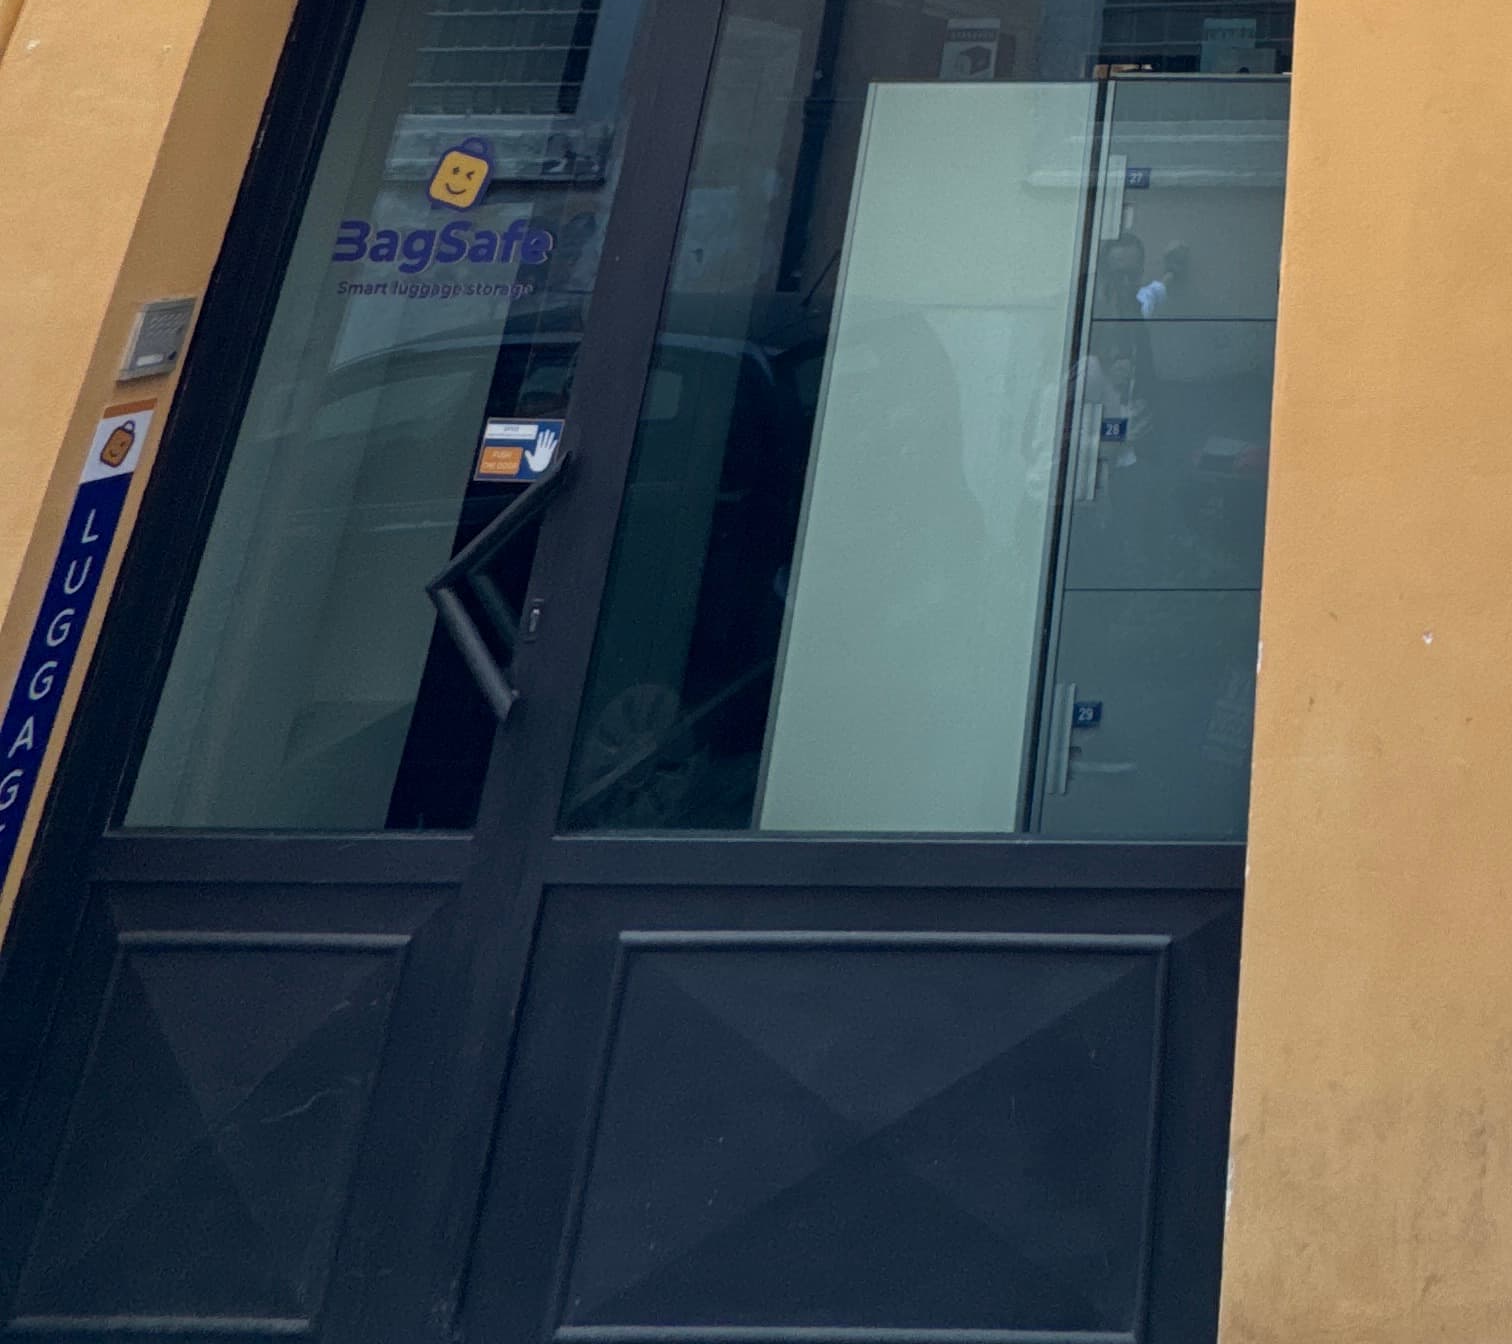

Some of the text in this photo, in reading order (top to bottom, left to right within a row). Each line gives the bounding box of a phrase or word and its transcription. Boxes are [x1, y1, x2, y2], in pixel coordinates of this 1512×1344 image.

[332, 218, 555, 274] BagSafe
[337, 280, 534, 299] Smart luggage storage
[0, 509, 99, 833] LUGGAG
